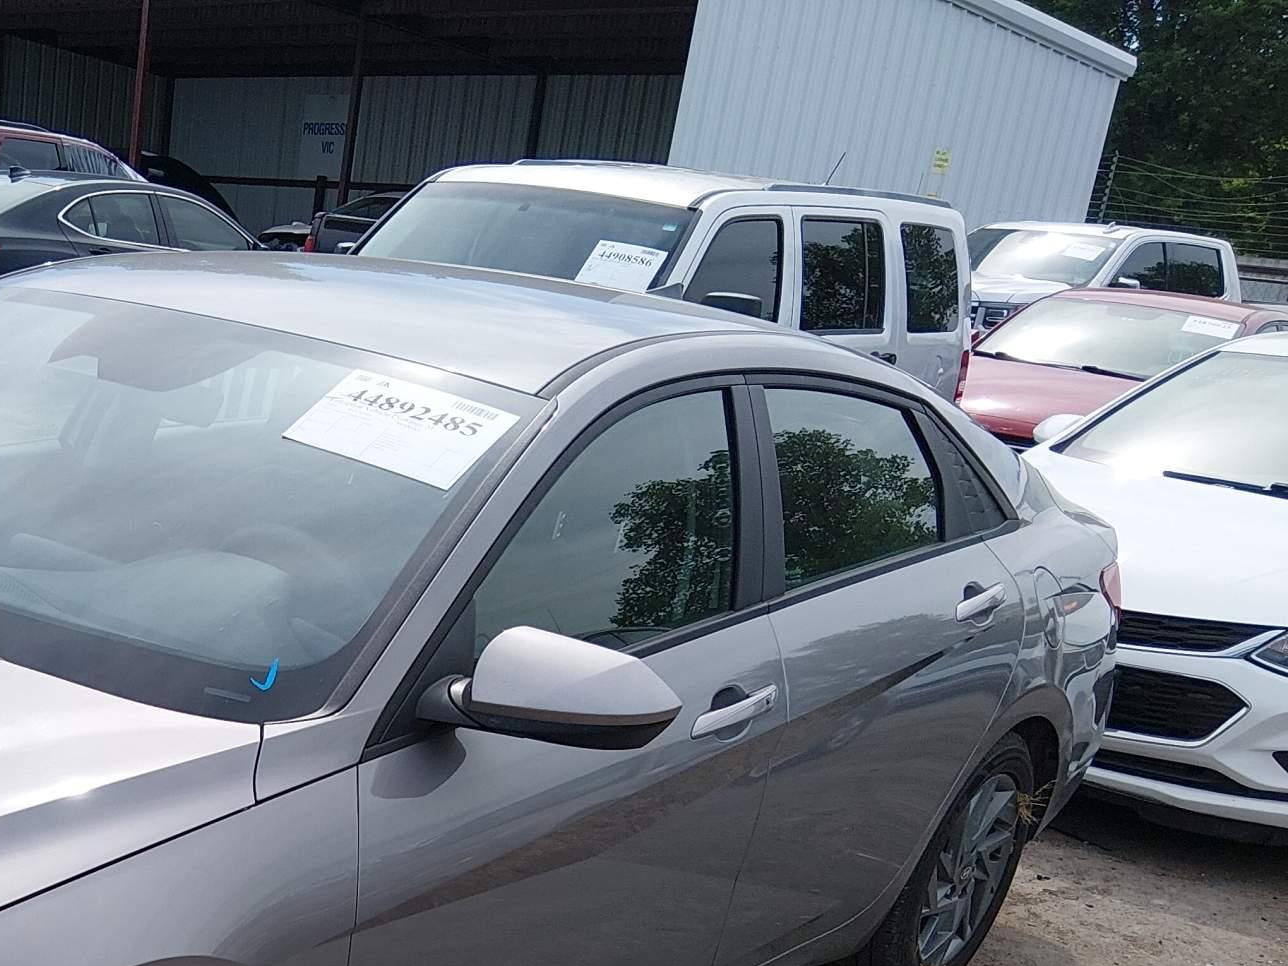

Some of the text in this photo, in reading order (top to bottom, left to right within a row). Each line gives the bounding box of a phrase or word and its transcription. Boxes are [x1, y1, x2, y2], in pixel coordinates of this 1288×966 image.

[321, 141, 335, 154] VIC
[598, 249, 653, 267] 44908586
[347, 389, 485, 437] 44892485
